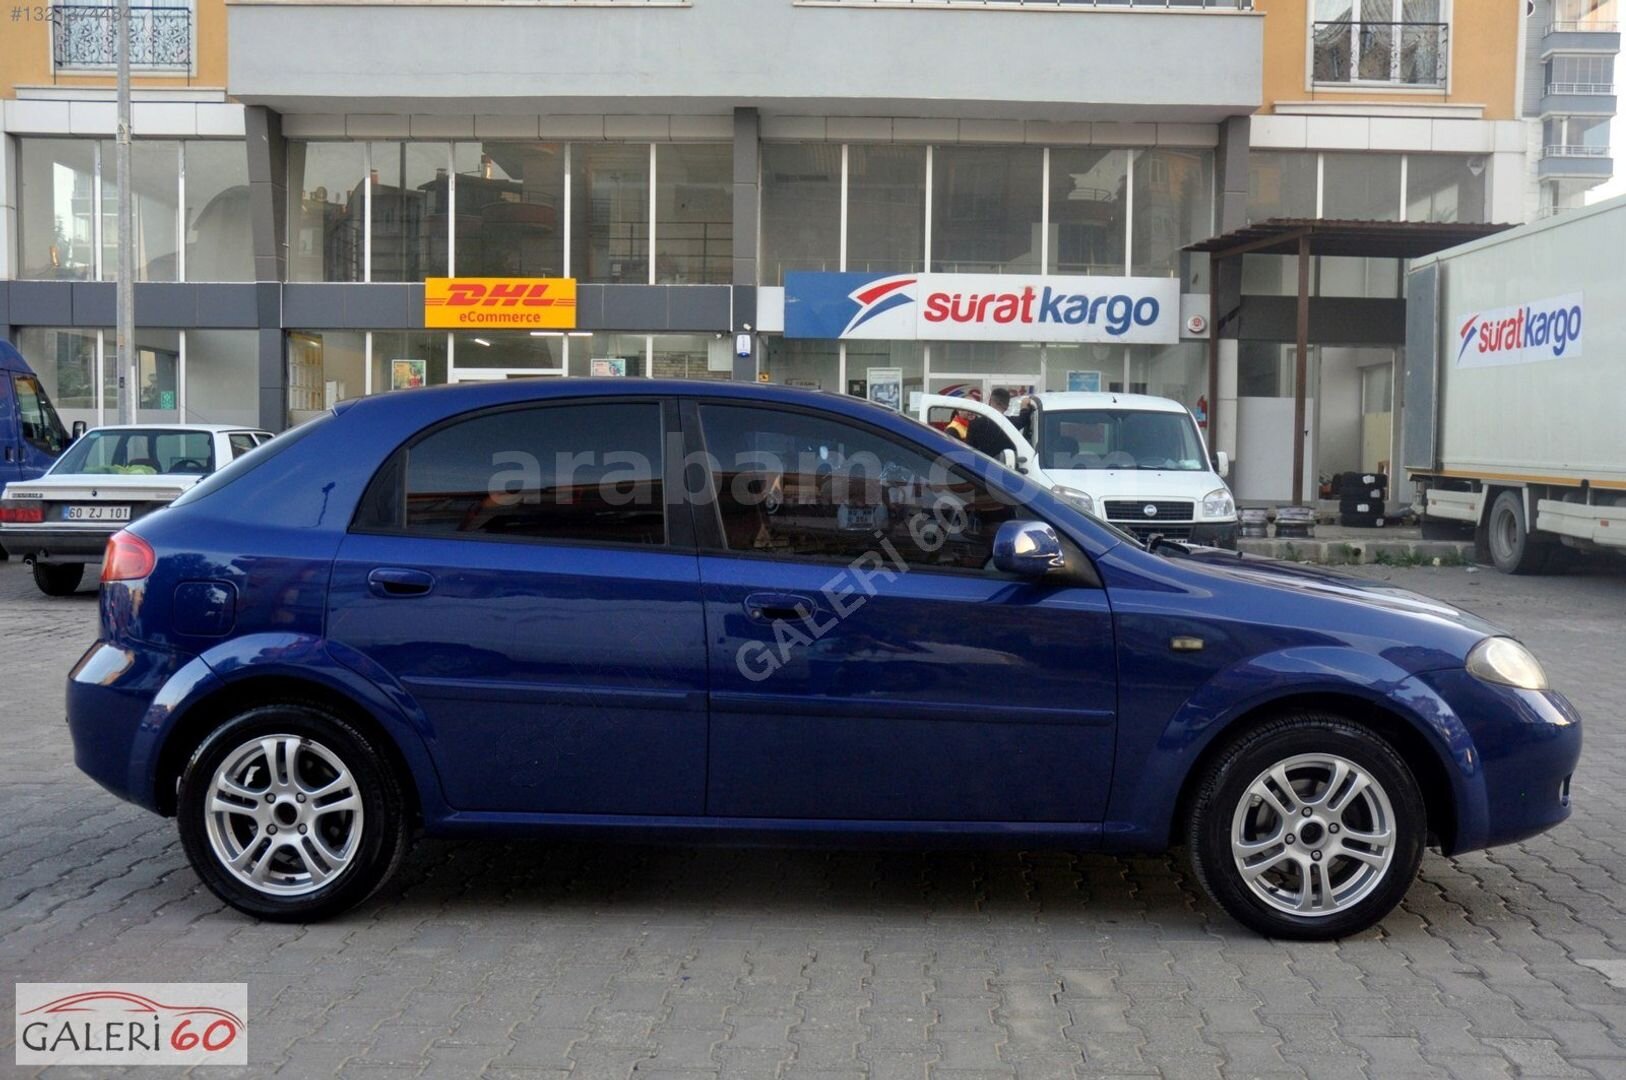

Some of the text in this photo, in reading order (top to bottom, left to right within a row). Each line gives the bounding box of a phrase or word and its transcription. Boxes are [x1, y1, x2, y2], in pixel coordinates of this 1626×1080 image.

[446, 284, 556, 306] DHL
[459, 311, 541, 323] eCommerce
[68, 507, 129, 519] 60 ZJ 101
